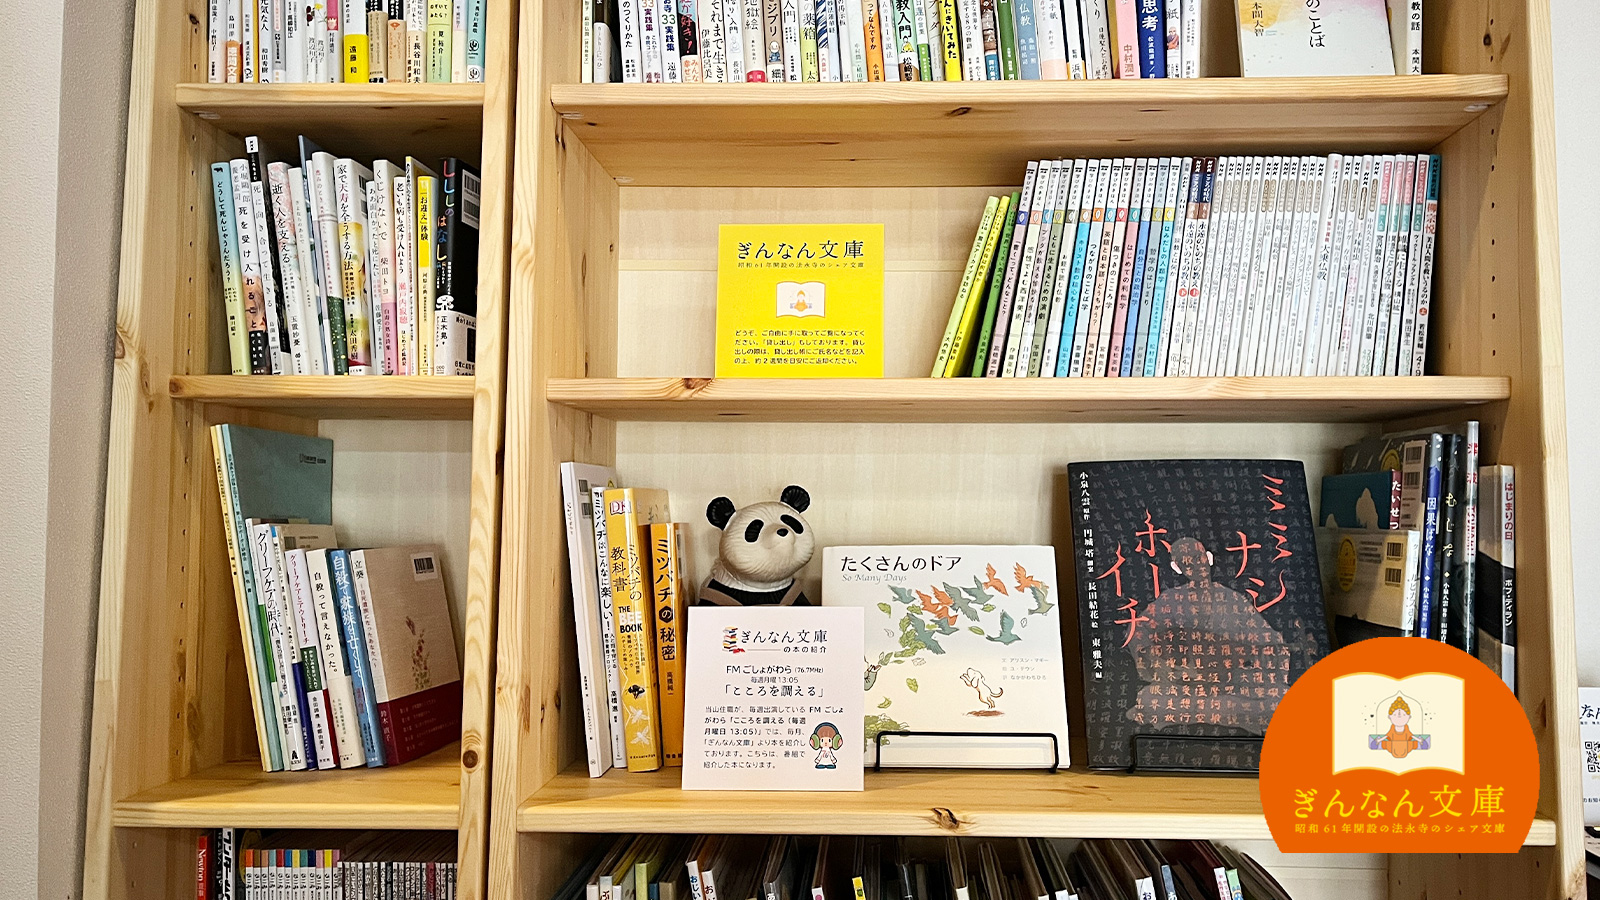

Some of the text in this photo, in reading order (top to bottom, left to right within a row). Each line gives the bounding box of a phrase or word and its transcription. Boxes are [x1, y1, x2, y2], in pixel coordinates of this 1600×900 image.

[622, 1, 633, 48] のつくりかた
[1251, 1, 1264, 37] 本間大智
[1305, 0, 1325, 48] のことば
[701, 29, 713, 79] 伊藤比呂美
[271, 183, 291, 263] 逝く人を支える
[337, 163, 354, 271] 家で天寿を全うする方法
[376, 169, 388, 241] くじけないで
[396, 182, 406, 275] 老いも病も受け入れよう
[420, 192, 429, 241] 「お迎え」体験
[1425, 203, 1437, 234] 柳宗悦
[238, 206, 257, 328] 死を受け入れること
[737, 240, 865, 260] ぎんなん文庫
[381, 257, 390, 295] 柴田トヨ
[398, 282, 409, 325] 瀬戸内寂聴
[1390, 480, 1402, 531] たいせつ
[1441, 492, 1455, 558] むじな
[1504, 483, 1514, 542] はじまりの日
[1079, 471, 1091, 506] 小泉八雲
[1087, 582, 1099, 620] 長田結花
[1424, 497, 1437, 571] 因果ばなし
[257, 529, 280, 637] グリーフケアの時代
[610, 546, 628, 593] 教科書
[628, 544, 643, 602] ミツバチの
[841, 555, 962, 573] たくさんのドア
[842, 573, 907, 586] So Many Days
[290, 554, 309, 645] グリーフケアとアウトリーチ
[314, 572, 338, 674] 自殺って言えなかった。
[333, 555, 362, 679] 自殺で家族を亡くして
[618, 605, 631, 613] THE
[618, 611, 643, 625] BEE
[654, 538, 677, 661] ミツバチの秘密
[619, 624, 643, 634] BOOK
[741, 629, 828, 645] ぎんなん文庫
[784, 645, 827, 654] の本の紹介
[726, 666, 741, 674] FM
[743, 665, 792, 674] ごしょがわら
[809, 706, 821, 714] FM
[198, 849, 207, 882] Newton
